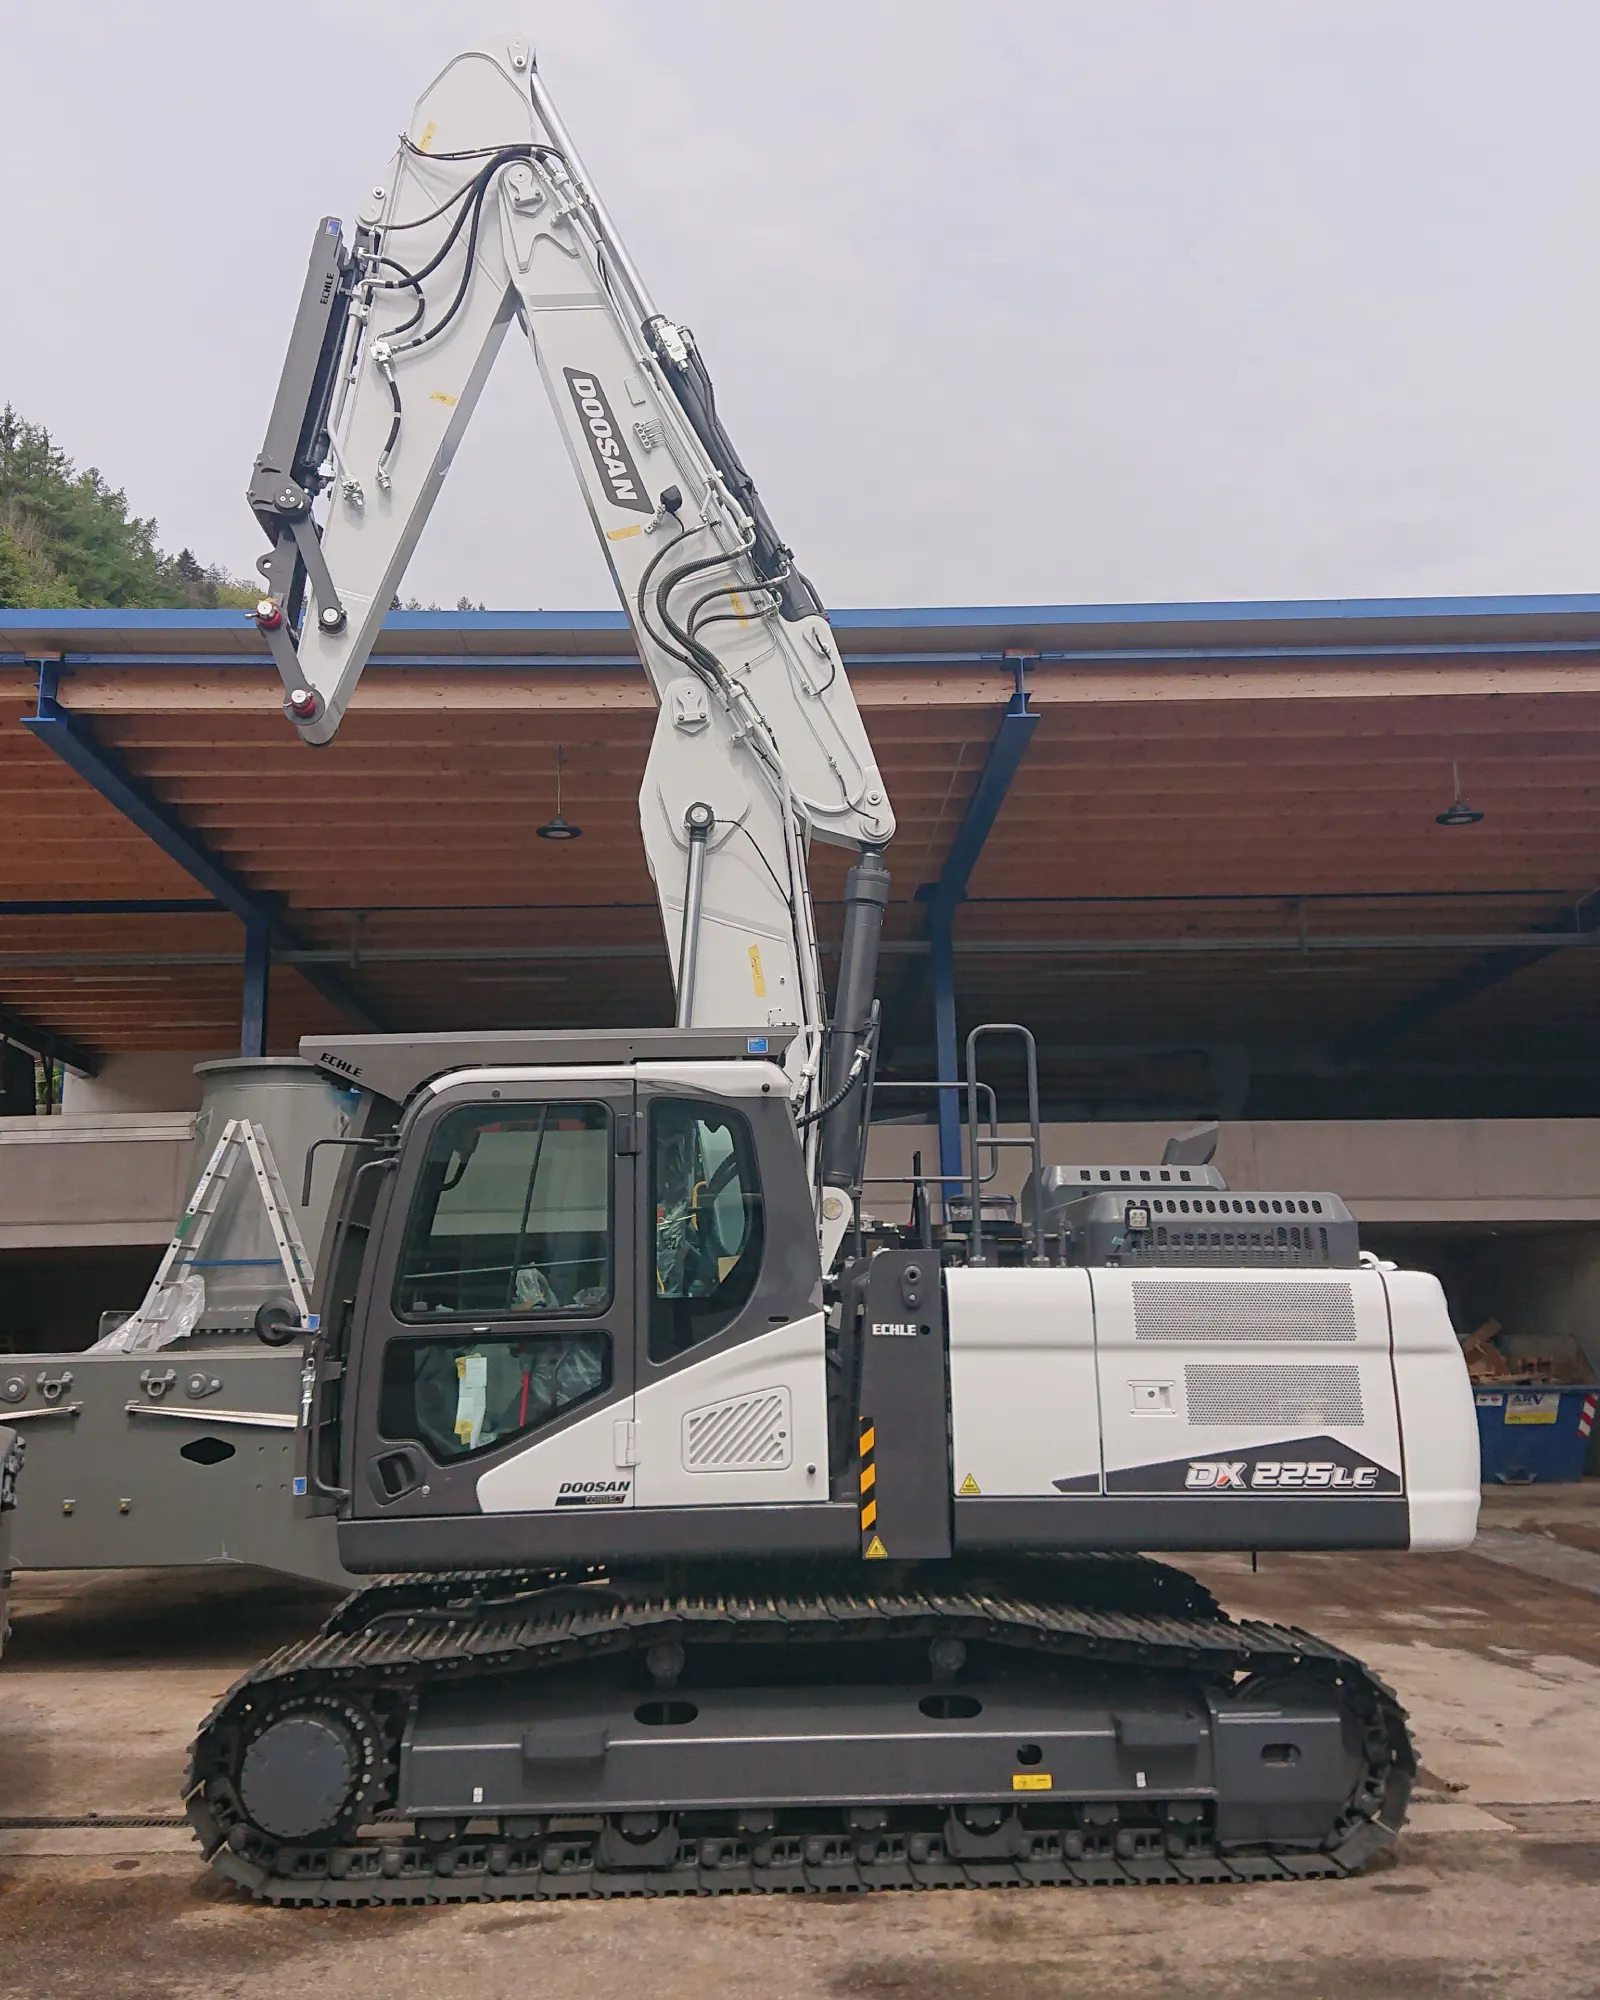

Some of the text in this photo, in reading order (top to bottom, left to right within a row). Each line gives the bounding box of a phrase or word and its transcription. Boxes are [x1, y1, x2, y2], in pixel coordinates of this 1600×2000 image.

[319, 272, 334, 305] ECHLE
[571, 378, 639, 500] DOOSAN
[320, 1052, 363, 1078] ECHLE
[872, 1323, 917, 1336] ECHLE
[559, 1481, 631, 1494] DOOSAN
[1184, 1462, 1248, 1488] DX
[585, 1494, 626, 1504] CONNECT
